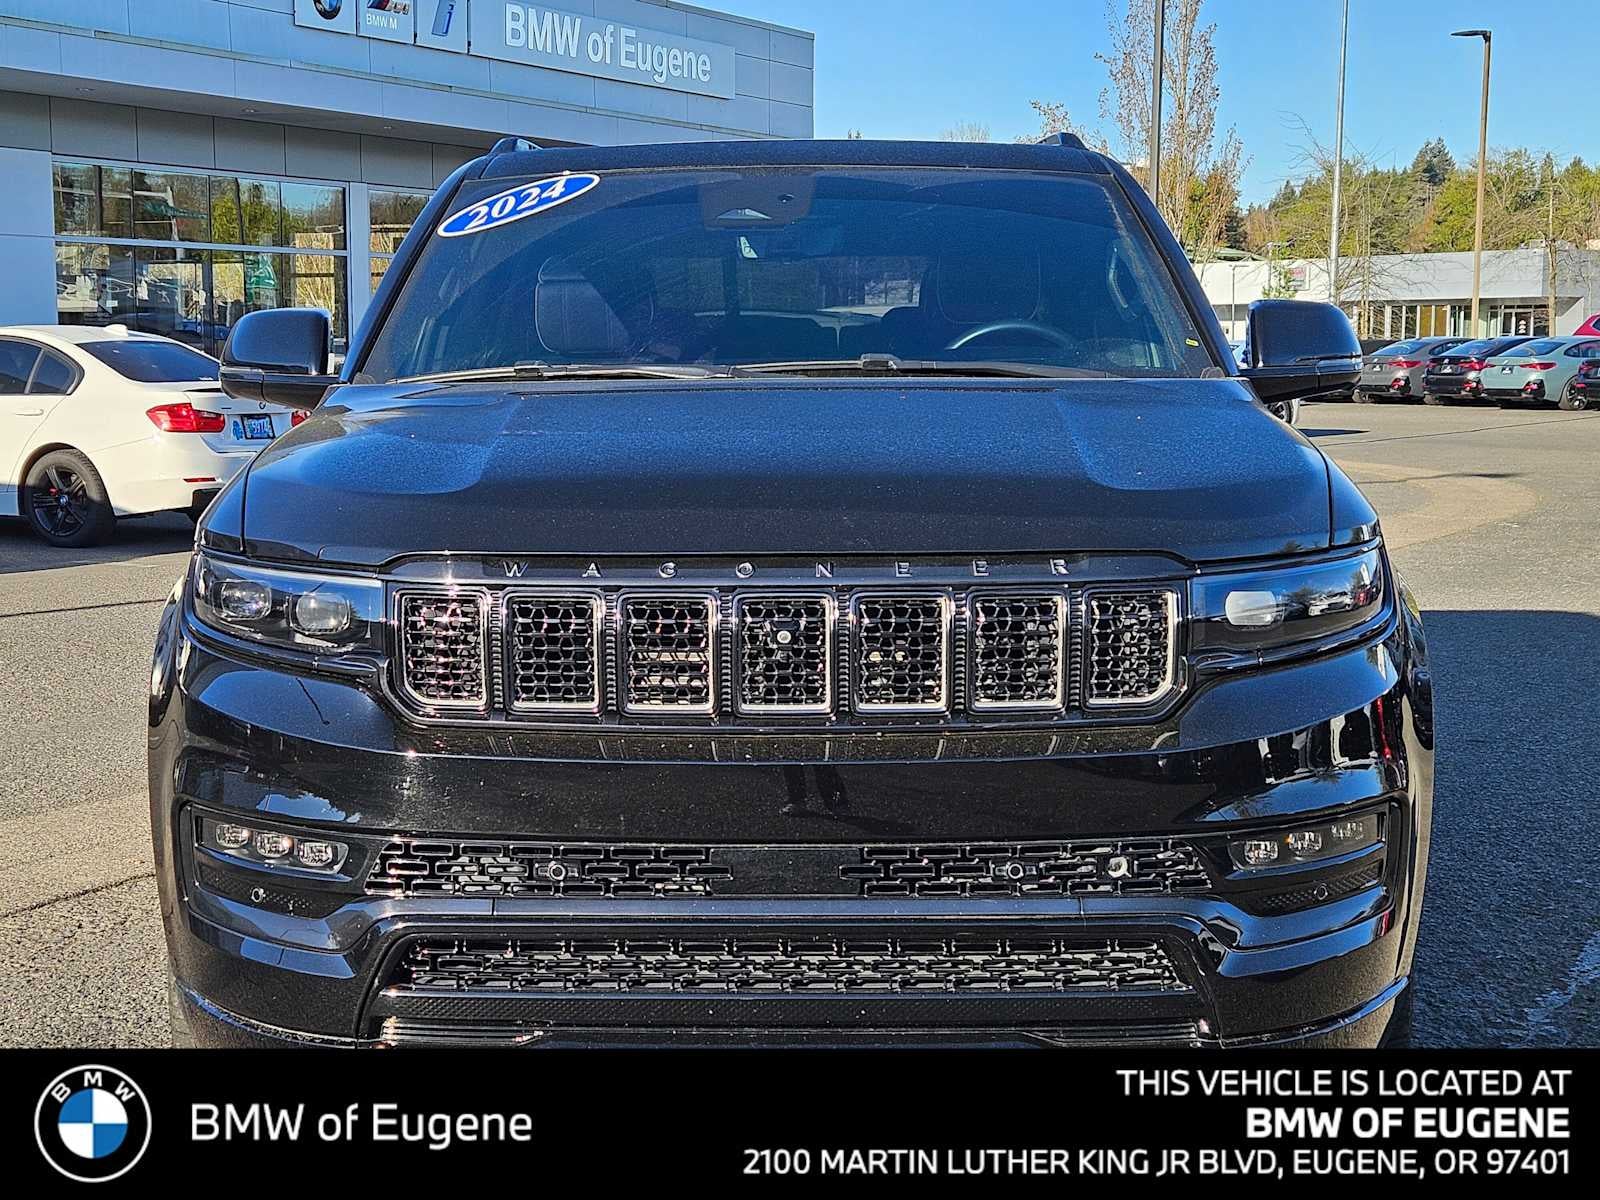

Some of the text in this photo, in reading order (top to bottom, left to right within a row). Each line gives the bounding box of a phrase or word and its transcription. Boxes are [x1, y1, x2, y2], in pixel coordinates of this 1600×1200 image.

[366, 13, 398, 30] BMW M
[504, 4, 711, 83] BMW of Eugene
[464, 178, 567, 230] 2024
[502, 557, 1069, 579] WAGONEER
